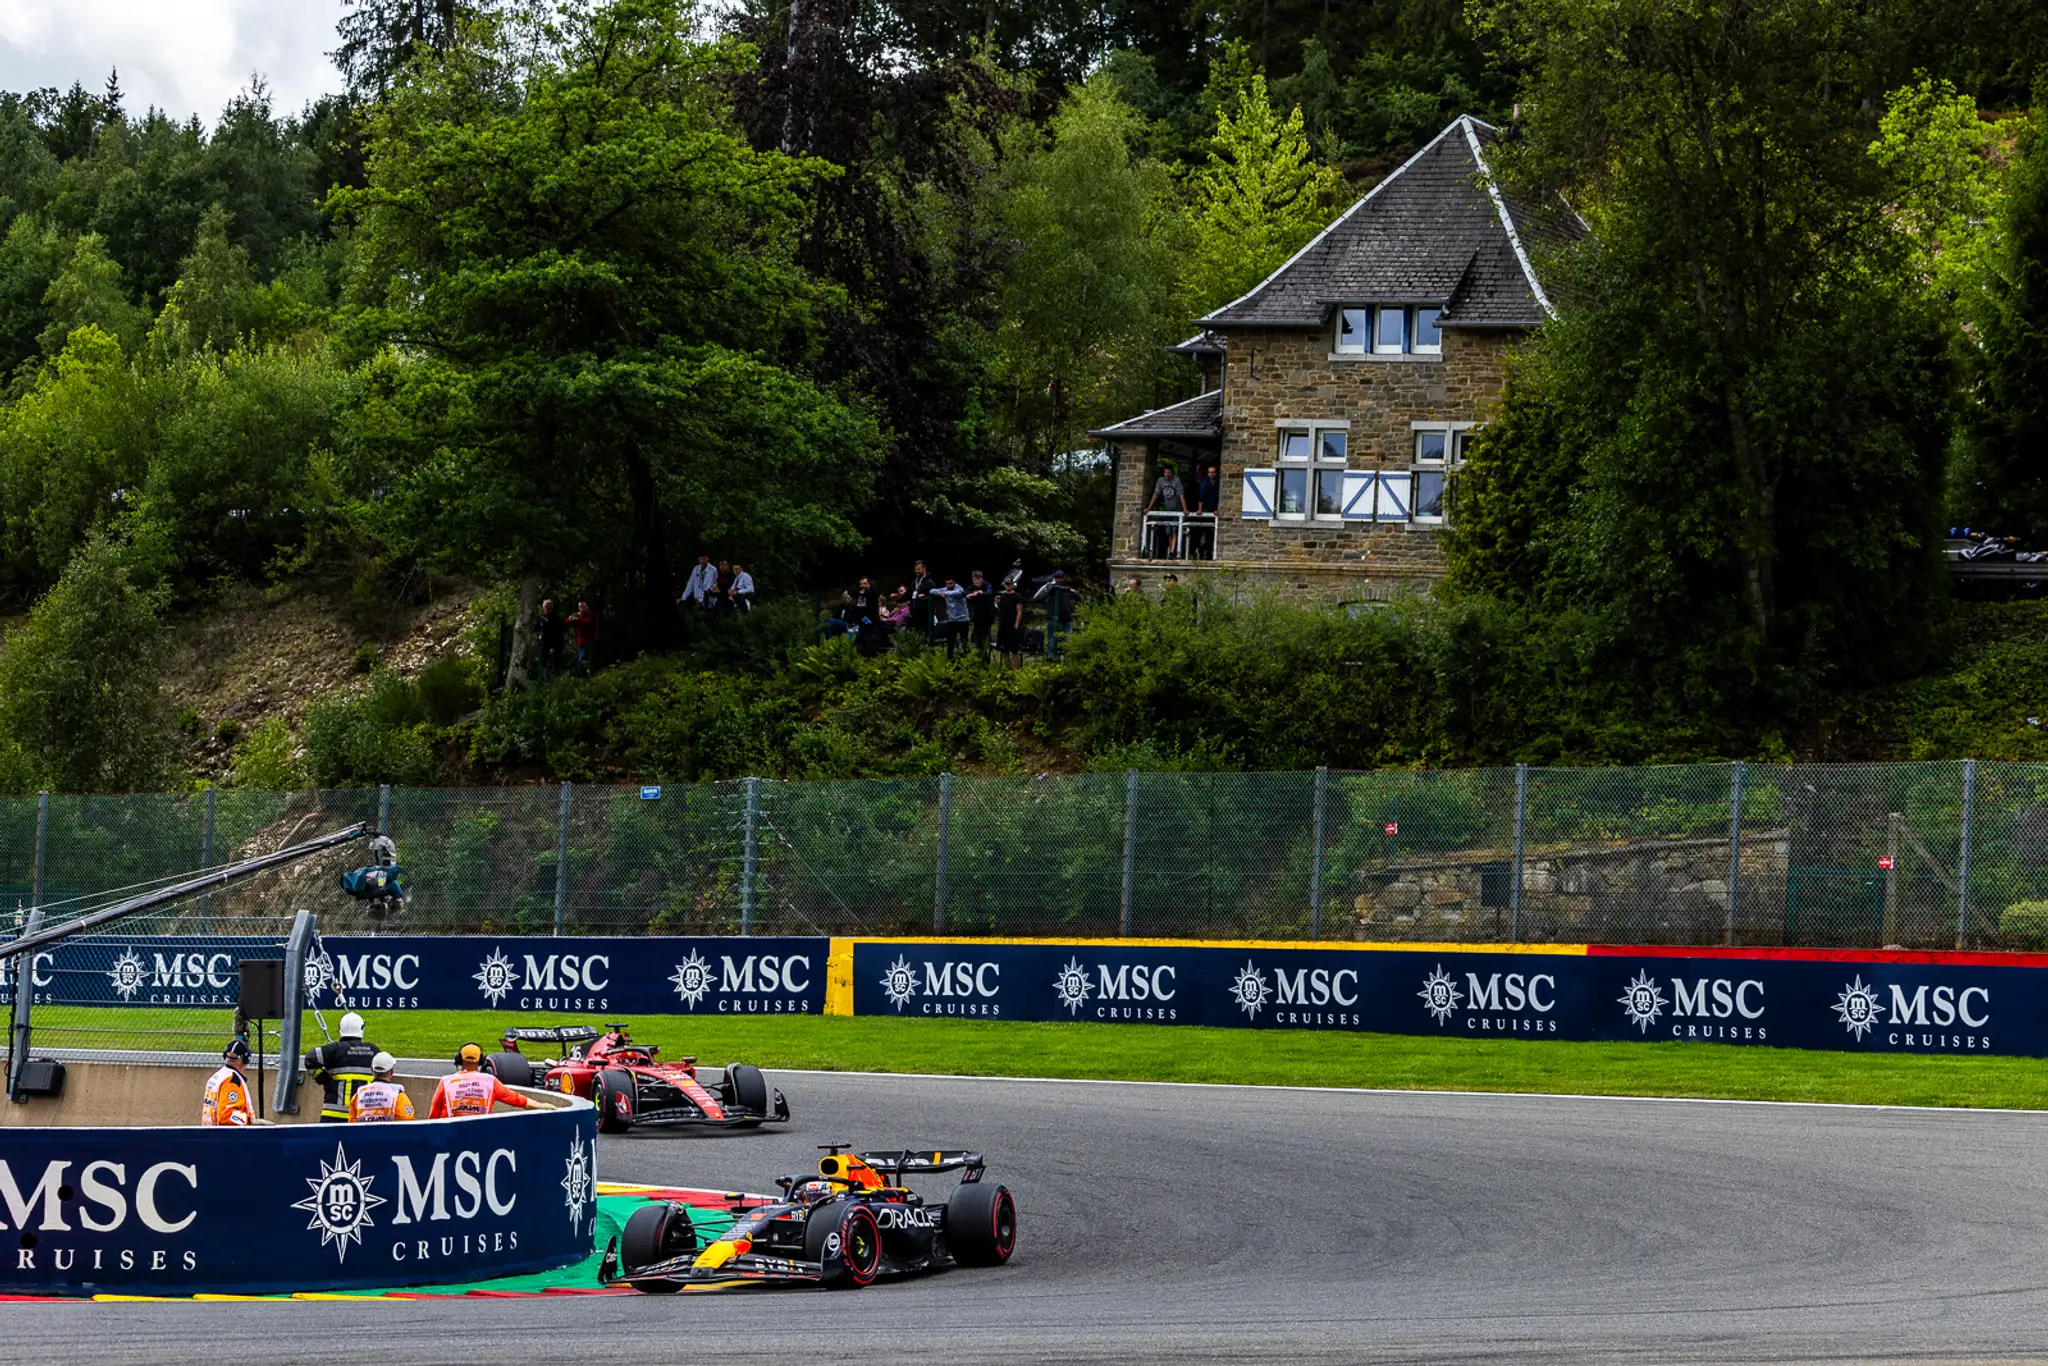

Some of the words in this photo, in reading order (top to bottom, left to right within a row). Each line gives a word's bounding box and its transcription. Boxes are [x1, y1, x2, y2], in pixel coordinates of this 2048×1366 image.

[337, 954, 419, 989] MSC
[521, 955, 609, 990] MSC
[719, 956, 809, 992] MSC
[923, 962, 1000, 996] MSC
[1097, 965, 1175, 1000] MSC
[150, 994, 230, 1004] CRUISES
[1275, 969, 1358, 1005] MSC
[1466, 973, 1555, 1011] MSC
[1671, 979, 1765, 1018] MSC
[335, 997, 418, 1008] CRUISES
[521, 998, 608, 1009] CRUISES
[719, 1000, 808, 1012] CRUISES
[923, 1003, 999, 1014] CRUISES
[1097, 1007, 1176, 1019] CRUISES
[1888, 985, 1989, 1027] MSC
[1276, 1012, 1359, 1024] CRUISES
[1468, 1018, 1556, 1031] CRUISES
[1673, 1025, 1766, 1039] CRUISES
[1890, 1033, 1990, 1048] CRUISES
[570, 1045, 581, 1060] 16
[0, 1159, 198, 1233] MSC
[392, 1149, 517, 1225] MSC
[392, 1230, 518, 1261] CRUISES
[17, 1249, 197, 1270] RUISES
